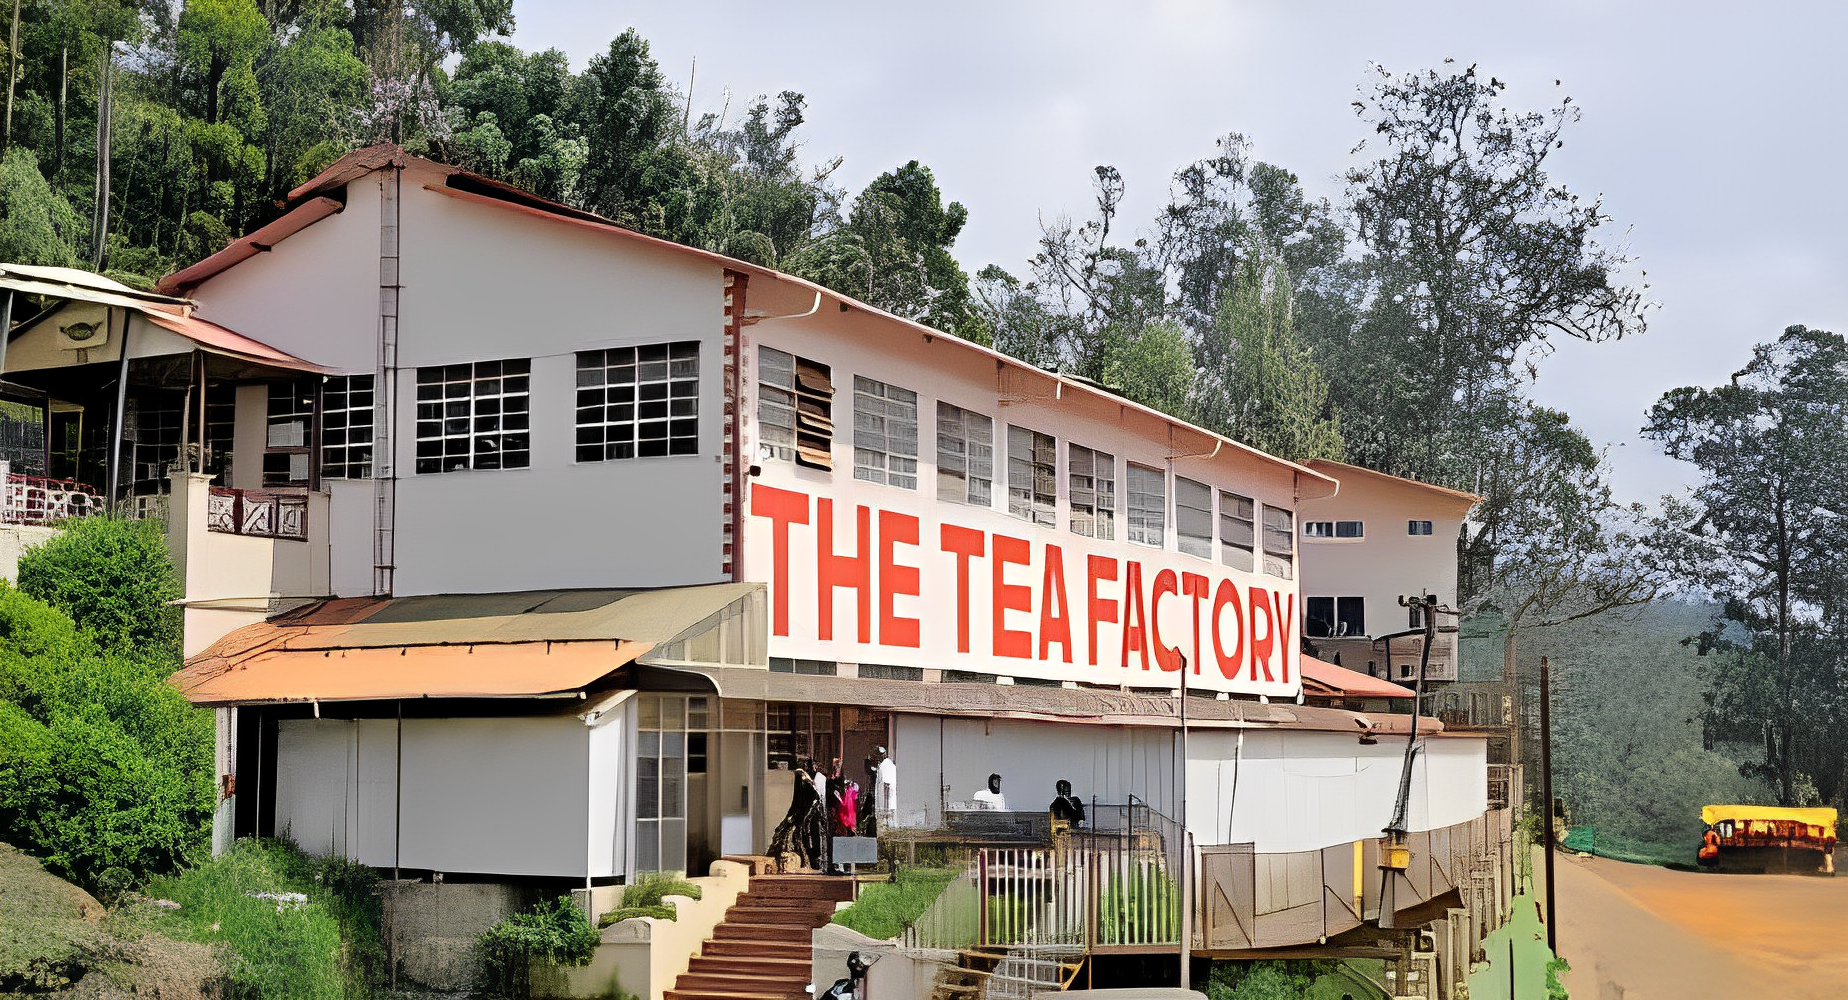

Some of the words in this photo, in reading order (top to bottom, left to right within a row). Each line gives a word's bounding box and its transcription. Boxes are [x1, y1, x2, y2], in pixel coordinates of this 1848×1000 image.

[751, 482, 921, 649] THE
[940, 522, 1073, 664] TEA
[1086, 553, 1294, 684] FACTORY
